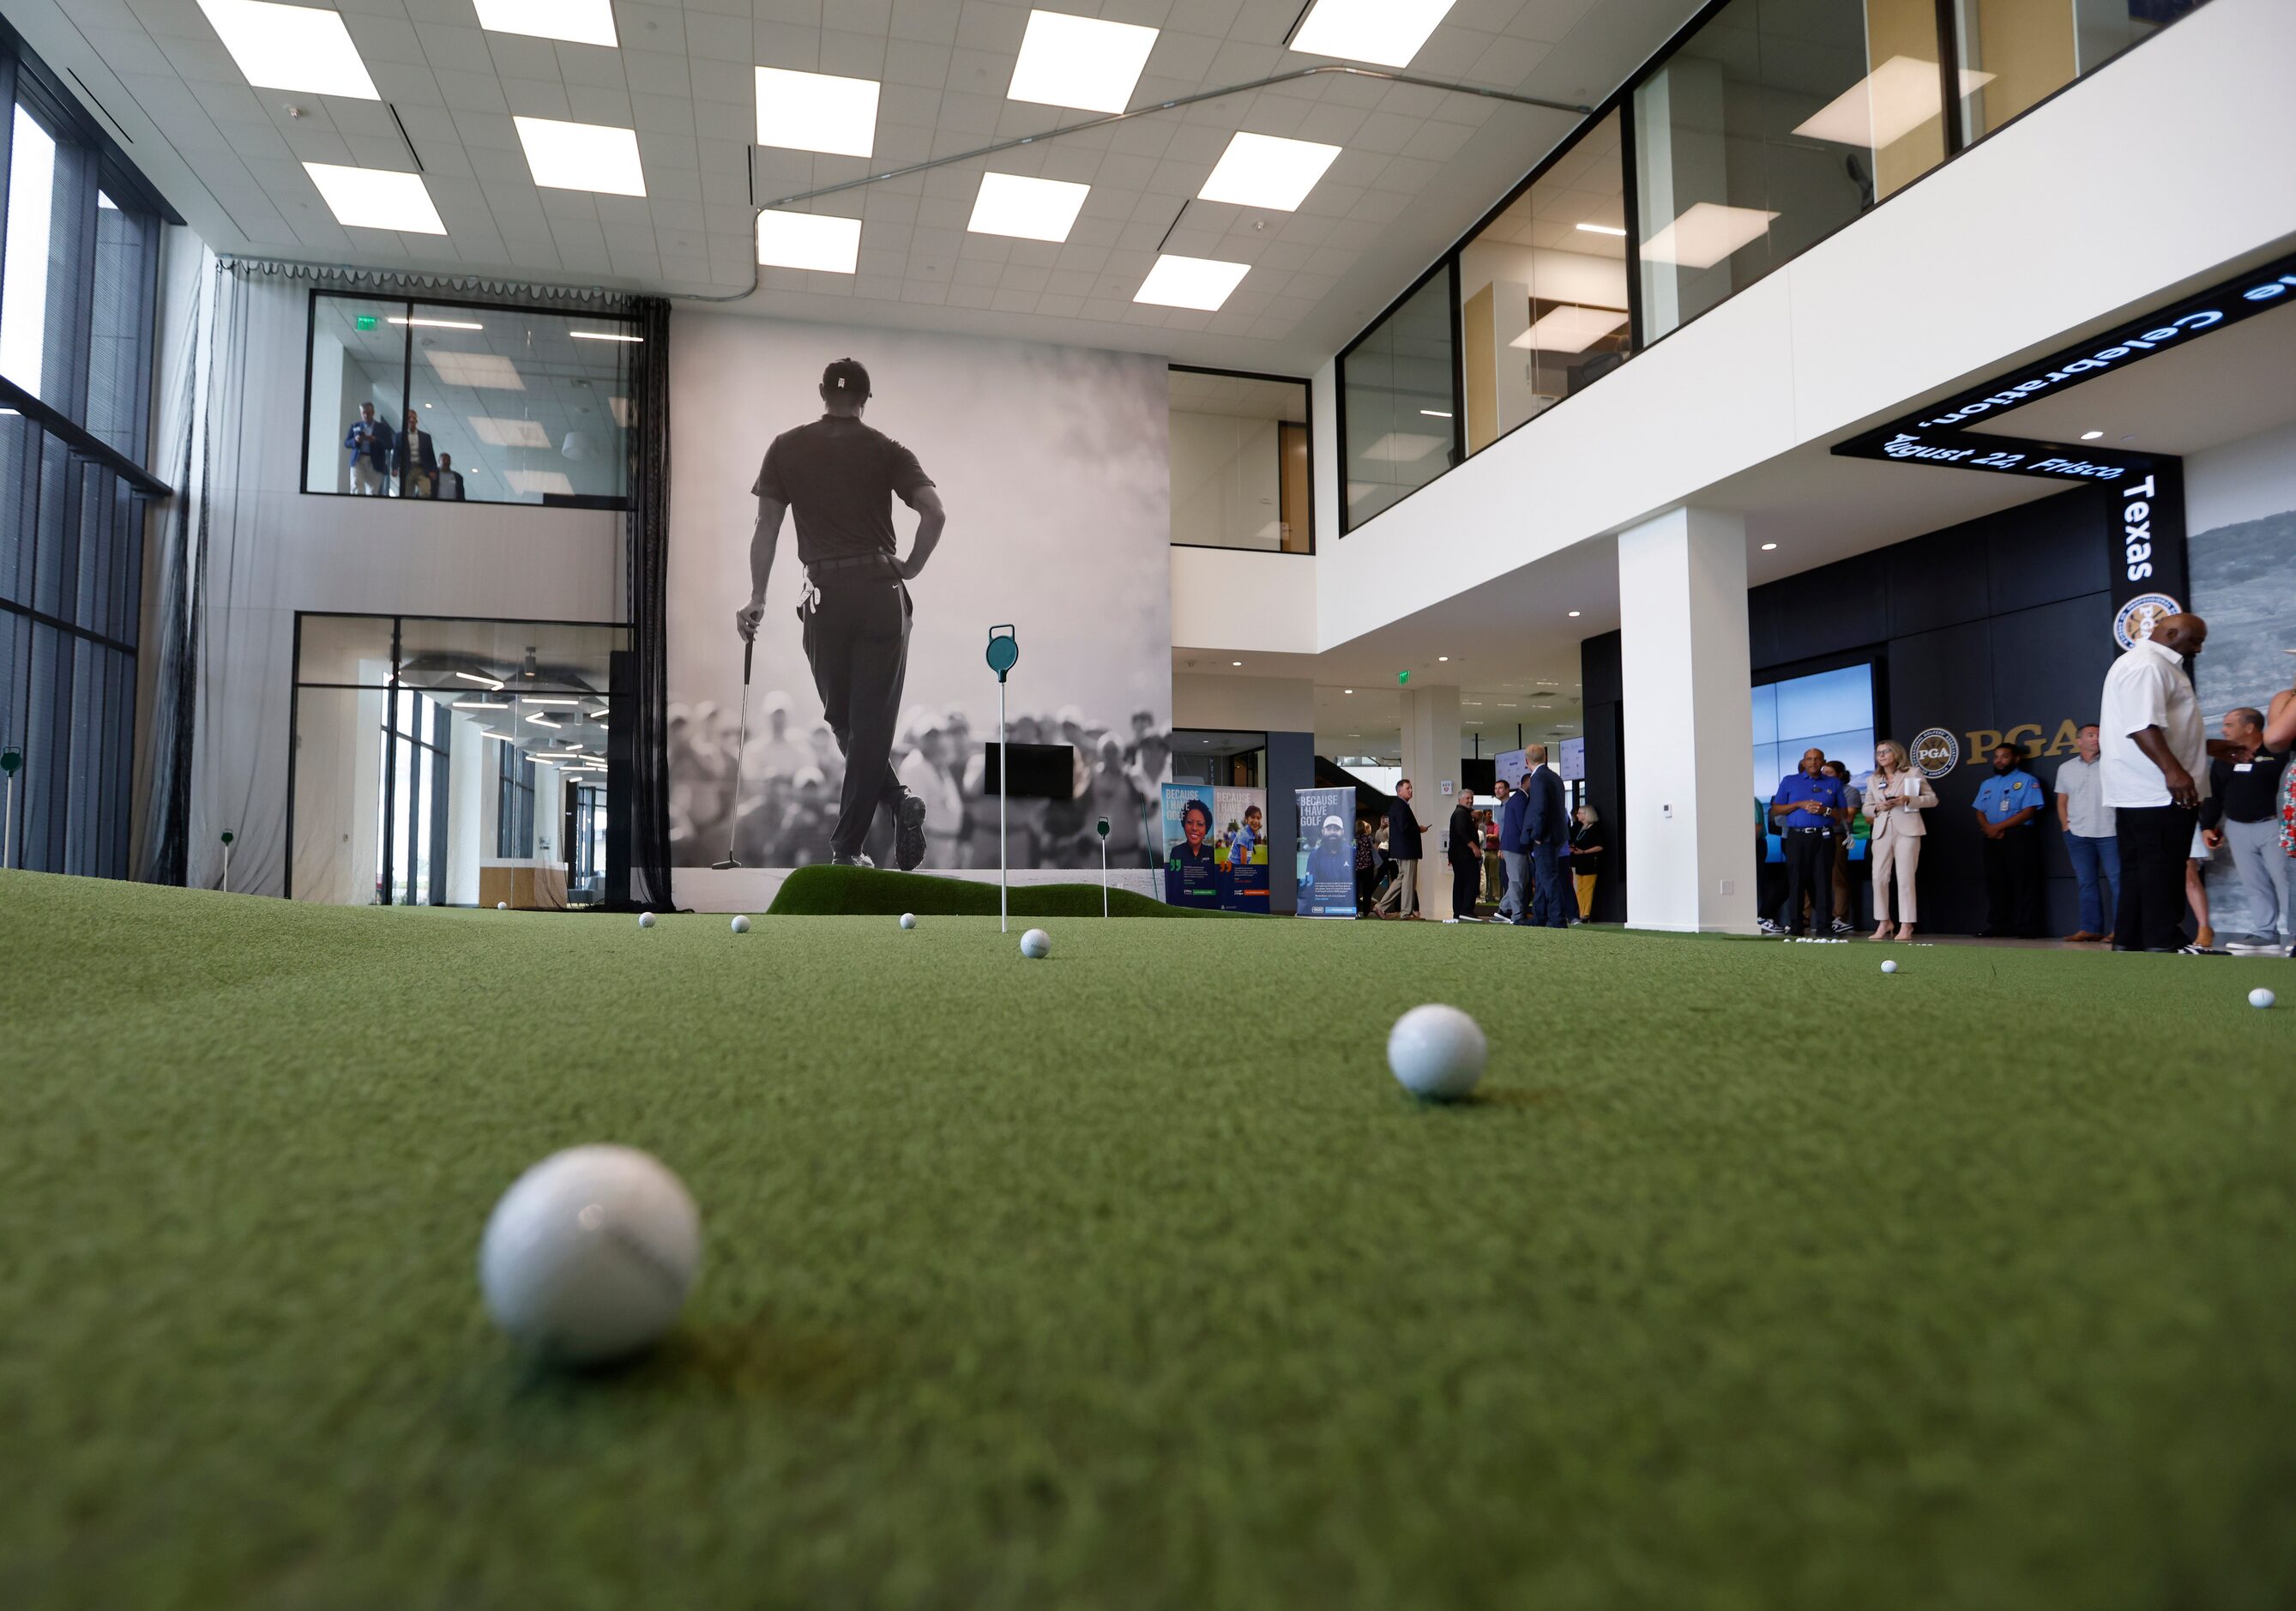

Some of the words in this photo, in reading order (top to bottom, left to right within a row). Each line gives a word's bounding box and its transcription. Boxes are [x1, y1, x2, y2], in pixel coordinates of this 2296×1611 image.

[1917, 311, 2224, 429] Celebration,
[1883, 433, 1977, 462] August
[1970, 452, 2026, 468] 22,
[2026, 458, 2125, 480] Frisco,
[2123, 474, 2155, 582] Texas
[1965, 718, 2082, 765] PGA
[1919, 747, 1949, 760] PGA
[1166, 788, 1199, 800] BECAUSE
[1217, 792, 1251, 803] BECAUSE
[1300, 794, 1338, 806] BECAUSE
[1170, 799, 1190, 811] HAVE
[1221, 802, 1242, 813] HAVE
[1305, 806, 1327, 816] HAVE
[1166, 811, 1185, 821] GOLF
[1300, 816, 1322, 827] GOLF
